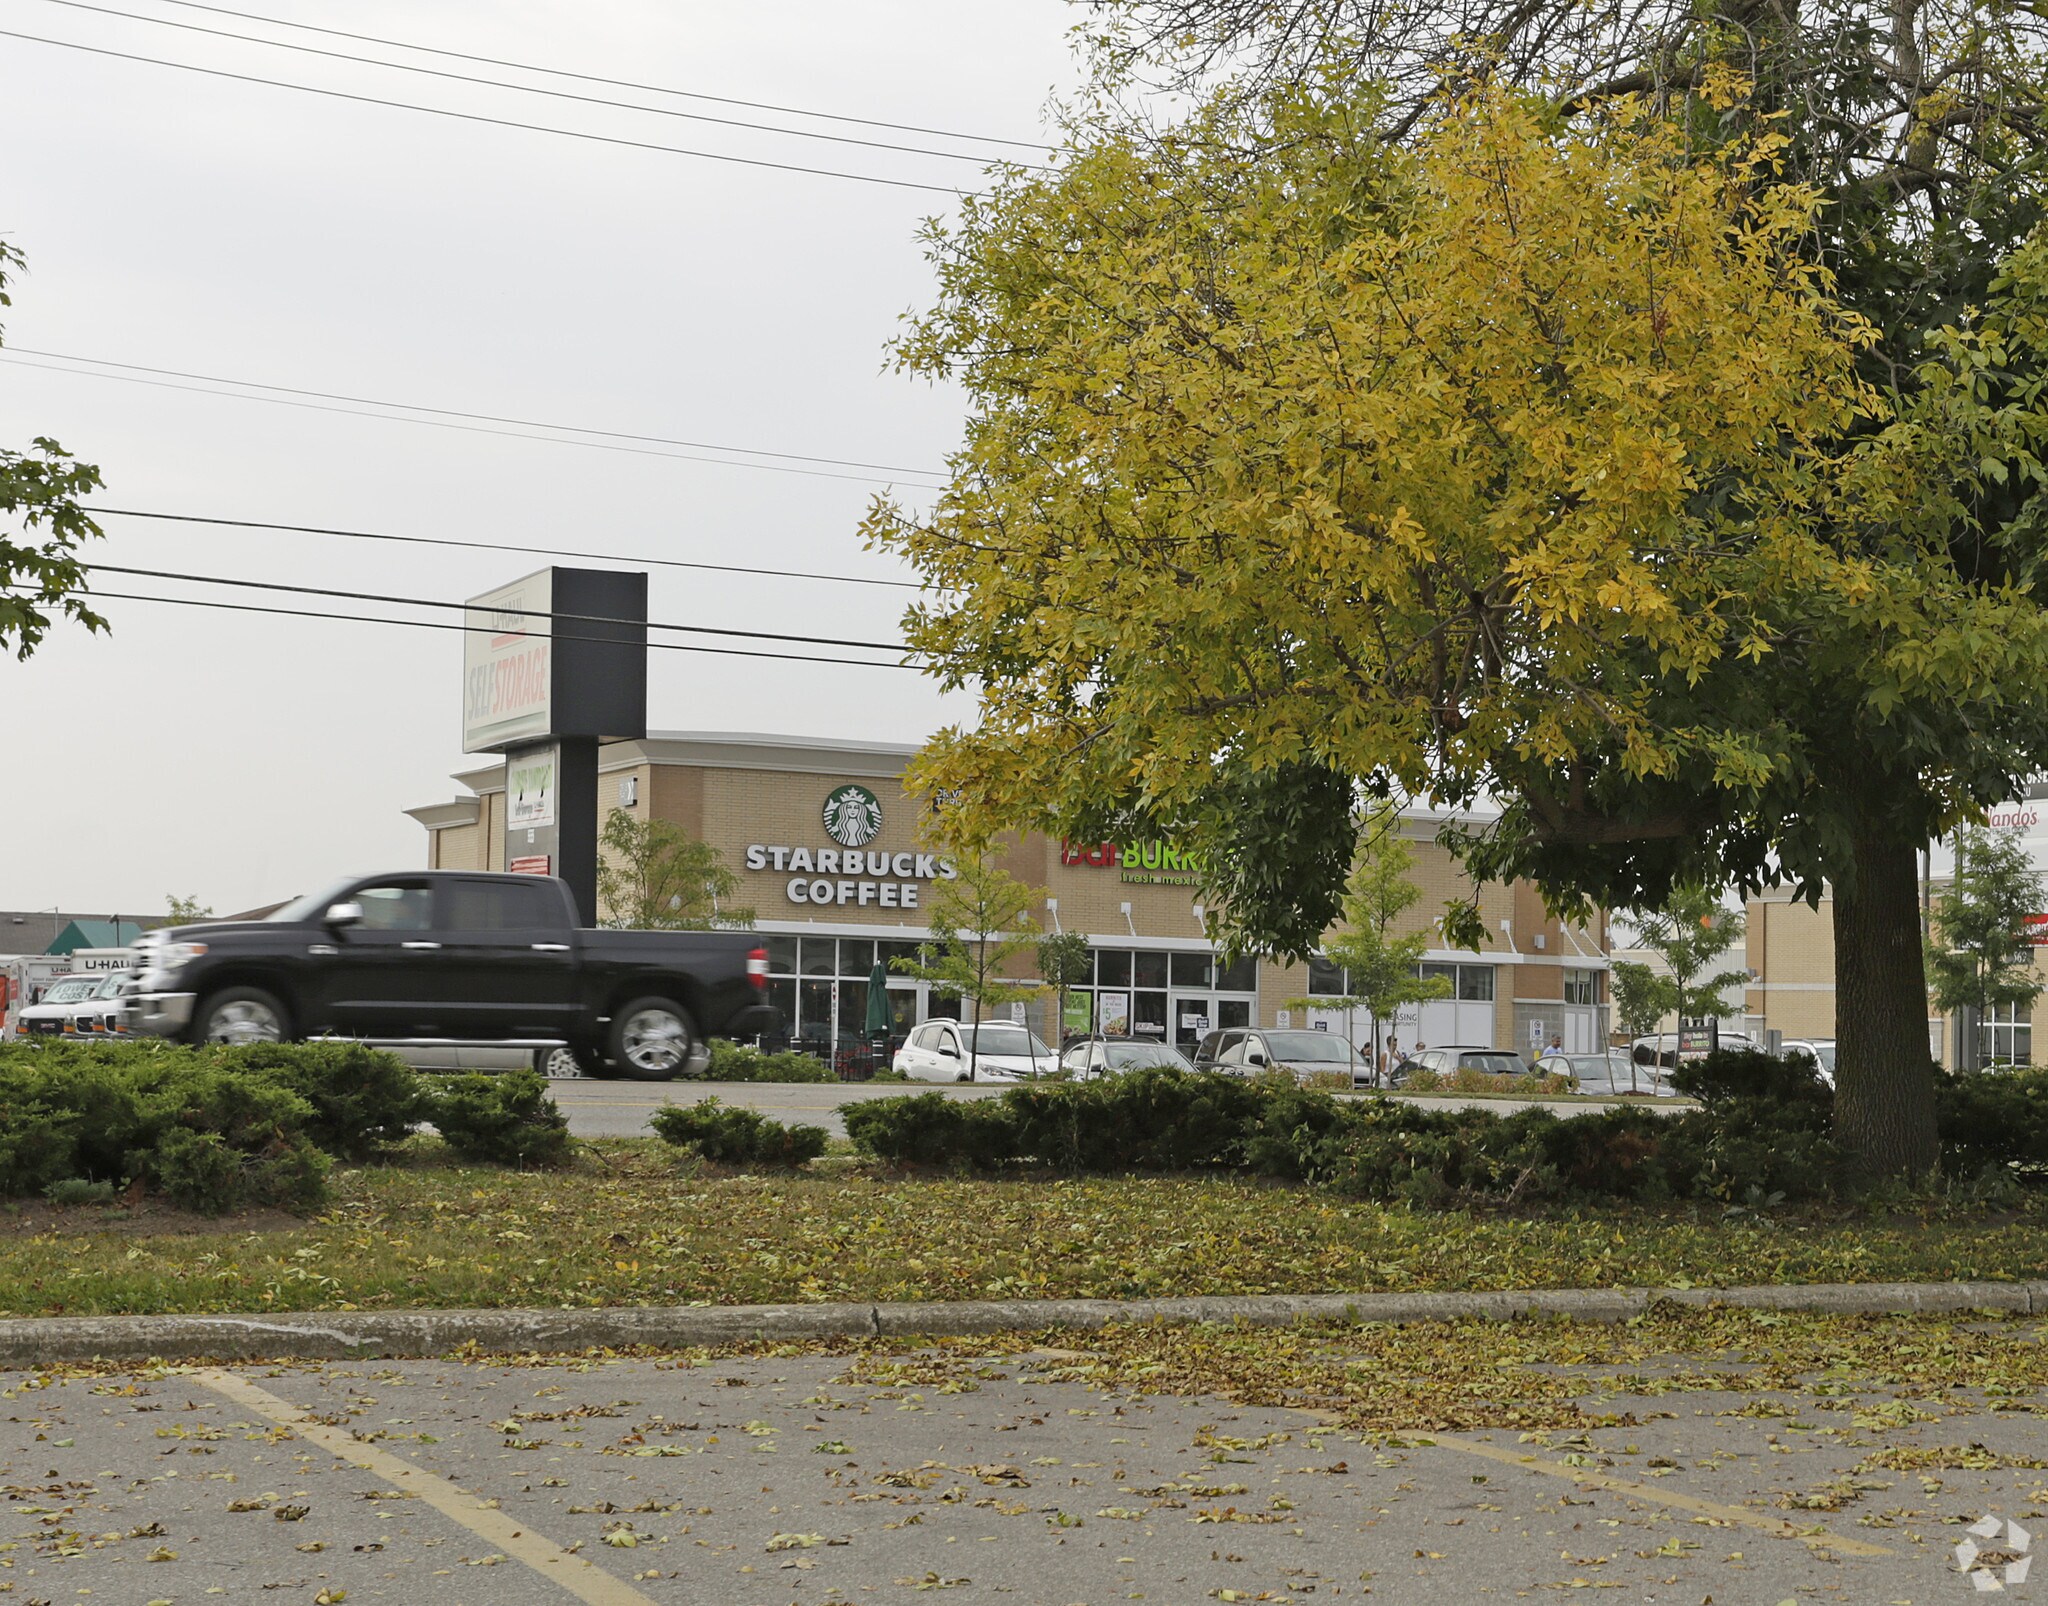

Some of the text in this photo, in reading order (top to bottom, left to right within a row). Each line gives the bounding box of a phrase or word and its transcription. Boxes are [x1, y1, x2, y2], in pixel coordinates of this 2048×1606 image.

[492, 645, 548, 714] STORAGE
[746, 845, 957, 879] STARBUCKS
[1121, 872, 1156, 883] fresh
[786, 878, 918, 908] COFFEE
